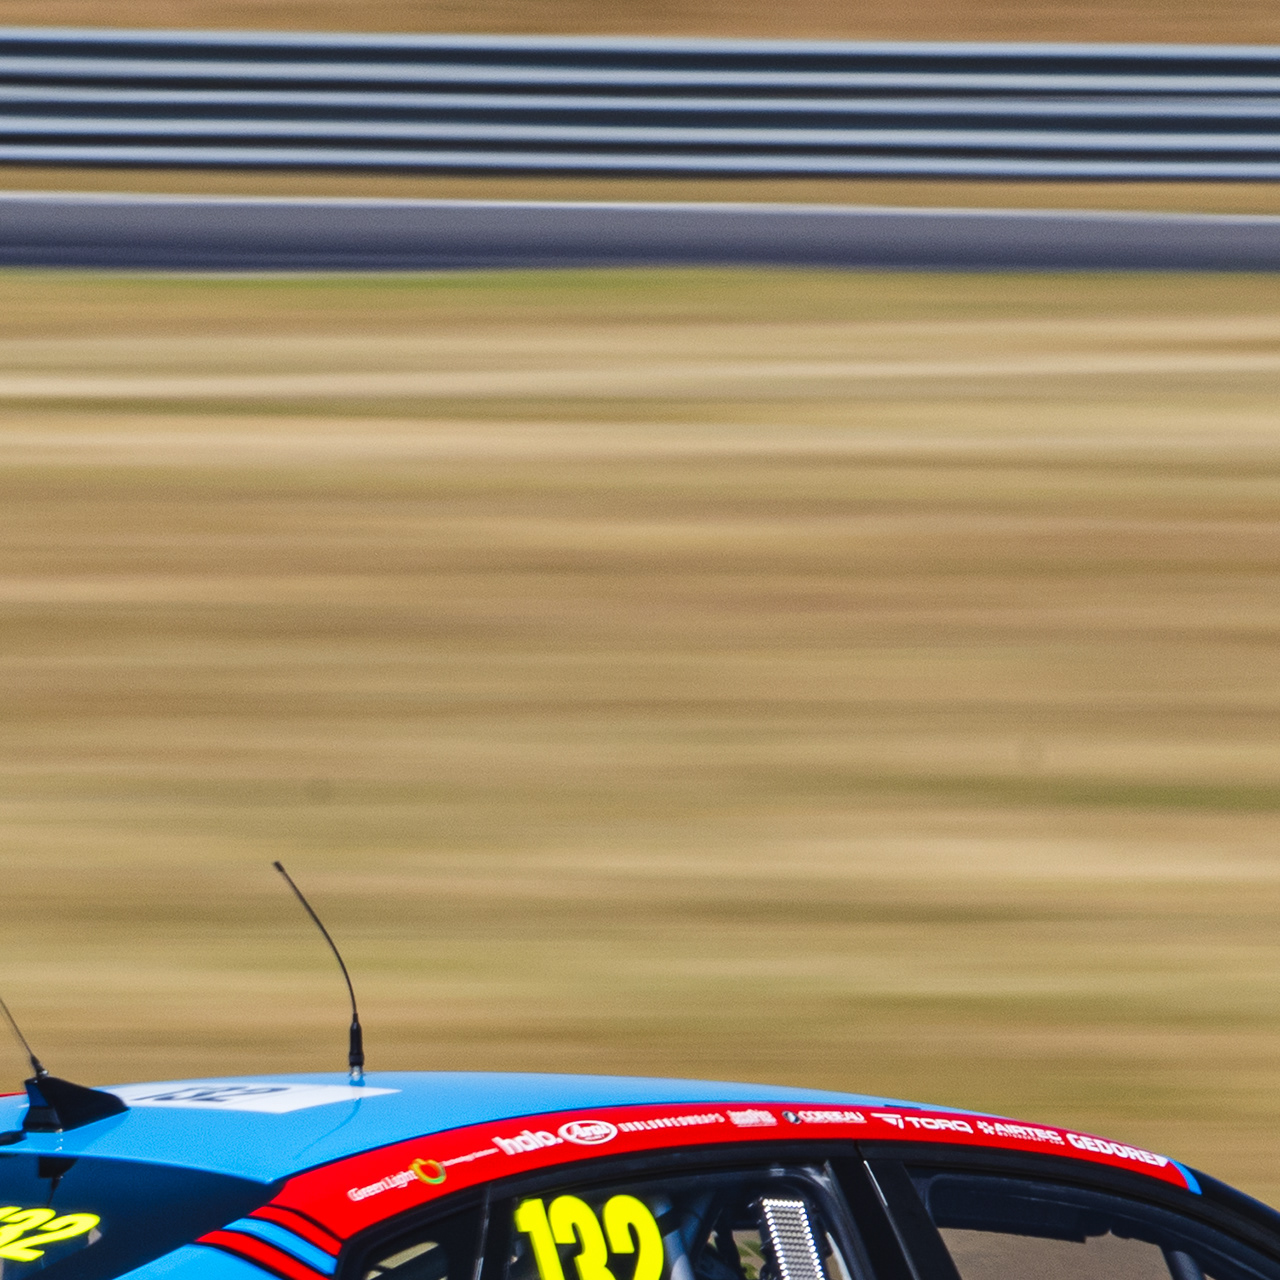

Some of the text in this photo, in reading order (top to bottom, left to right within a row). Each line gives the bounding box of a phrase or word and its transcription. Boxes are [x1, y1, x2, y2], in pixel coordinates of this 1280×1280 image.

[904, 1116, 974, 1134] TORQ
[994, 1122, 1063, 1142] AIRTEC
[1066, 1132, 1160, 1167] GEDORE
